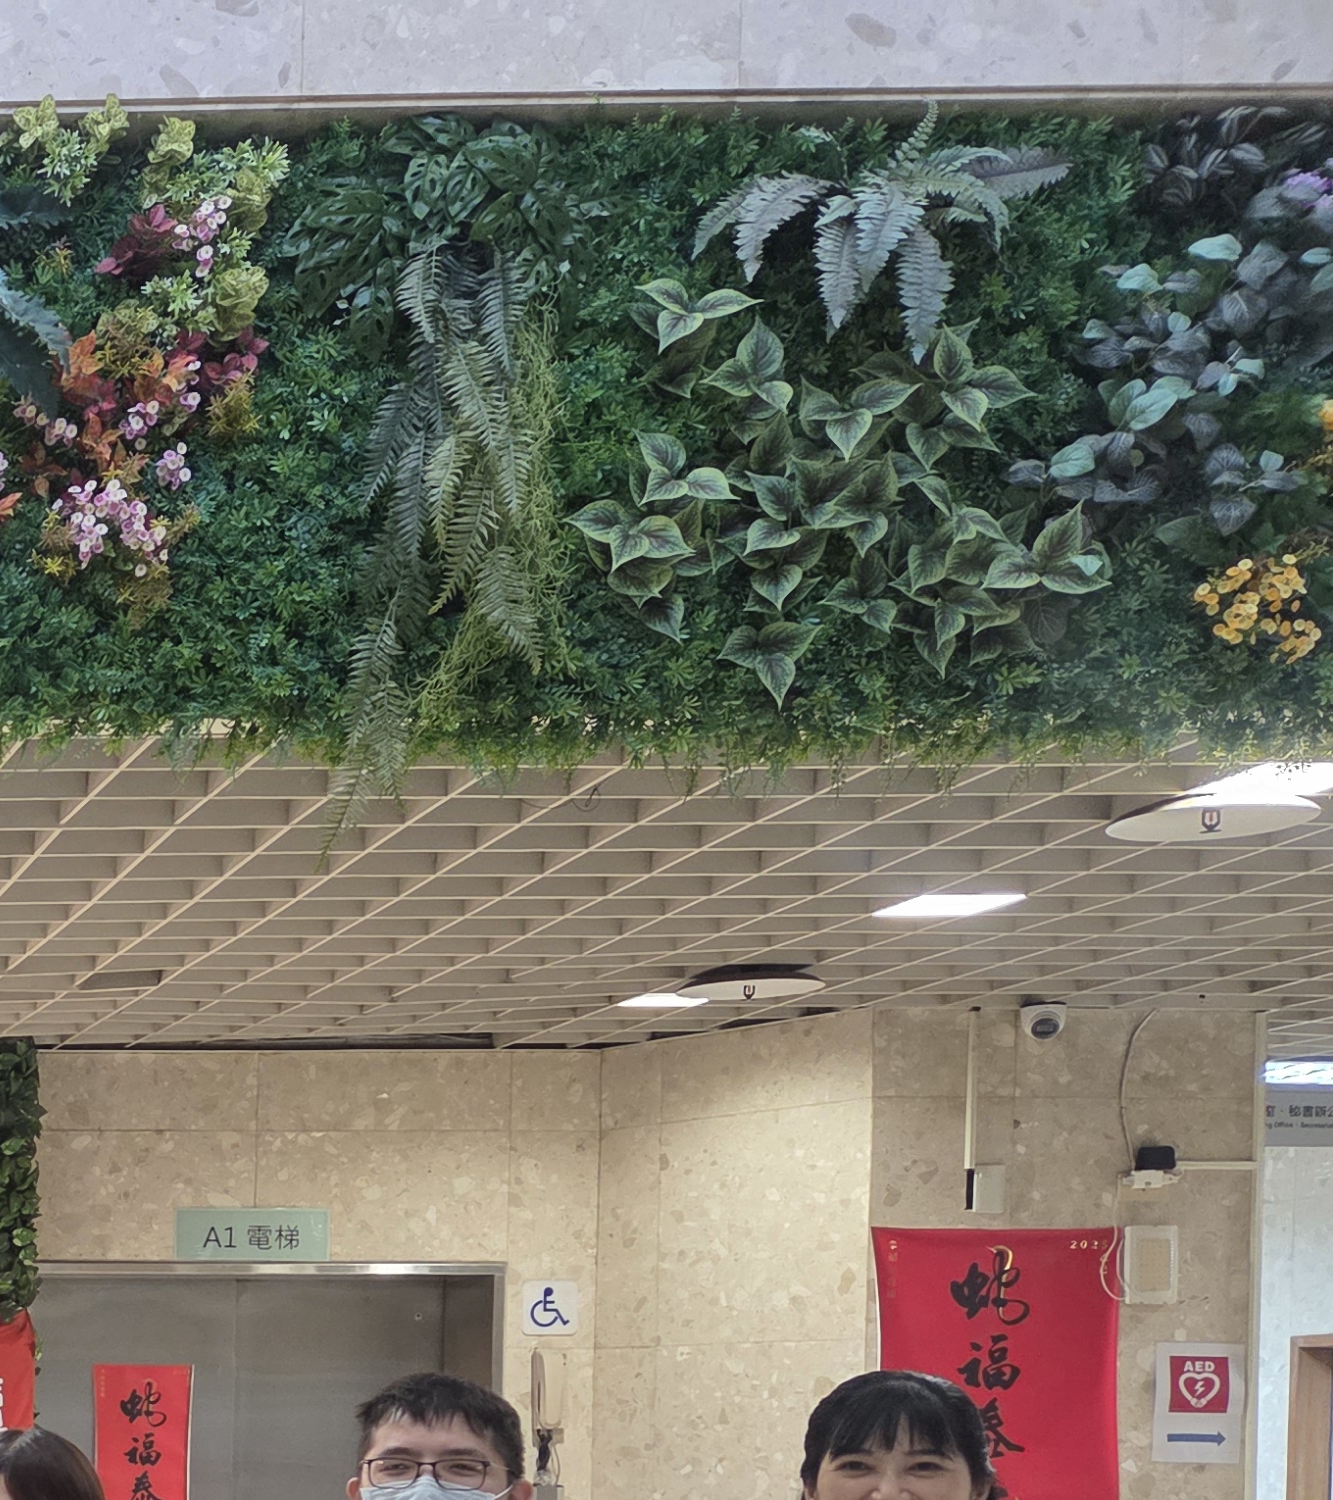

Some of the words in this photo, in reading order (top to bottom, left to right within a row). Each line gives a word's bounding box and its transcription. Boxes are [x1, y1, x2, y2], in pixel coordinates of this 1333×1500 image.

[203, 1226, 237, 1248] A1
[247, 1225, 300, 1250] 電梯
[1184, 1361, 1215, 1372] AED
